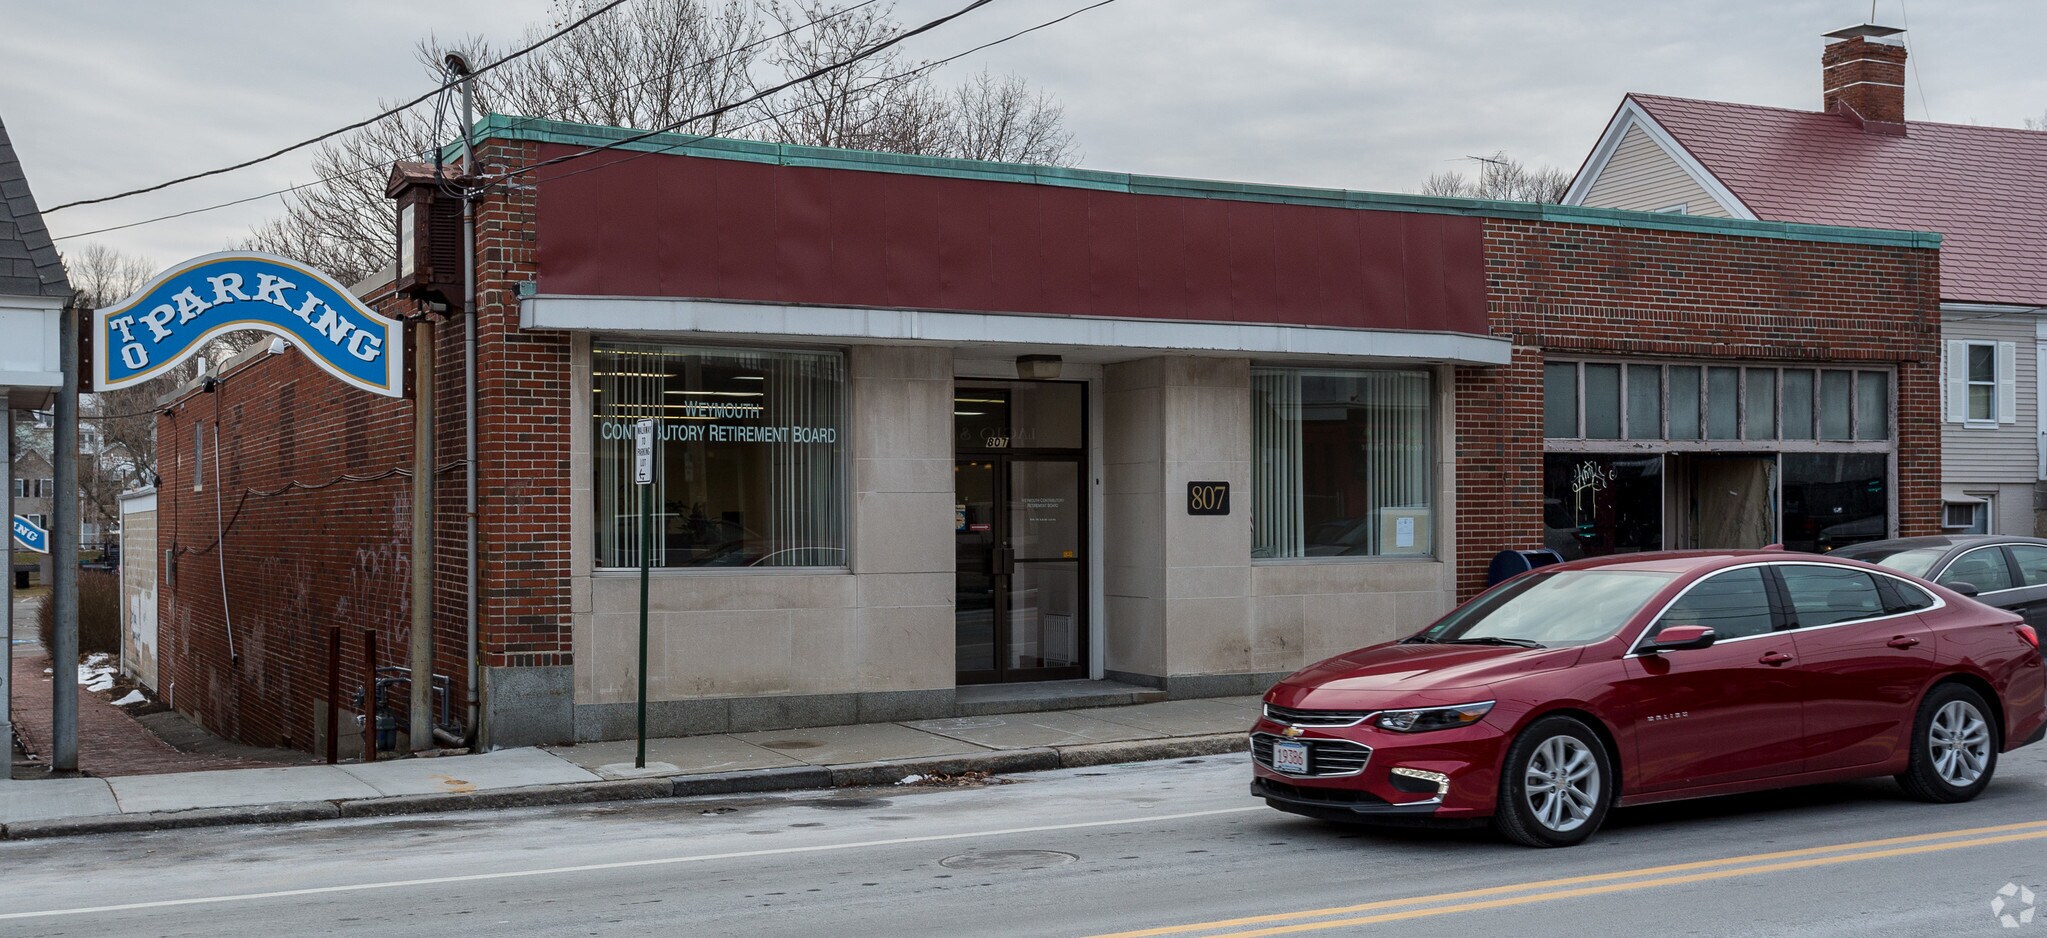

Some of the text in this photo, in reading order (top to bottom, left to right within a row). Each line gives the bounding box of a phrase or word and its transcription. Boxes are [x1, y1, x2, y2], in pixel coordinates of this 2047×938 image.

[110, 272, 384, 370] TO PARKING
[684, 400, 760, 419] WEYMOUTH
[709, 424, 789, 444] RETIREMENT
[793, 425, 837, 445] BOARD
[986, 437, 1008, 447] 807
[1191, 485, 1226, 510] 807
[1277, 749, 1304, 766] 19386
